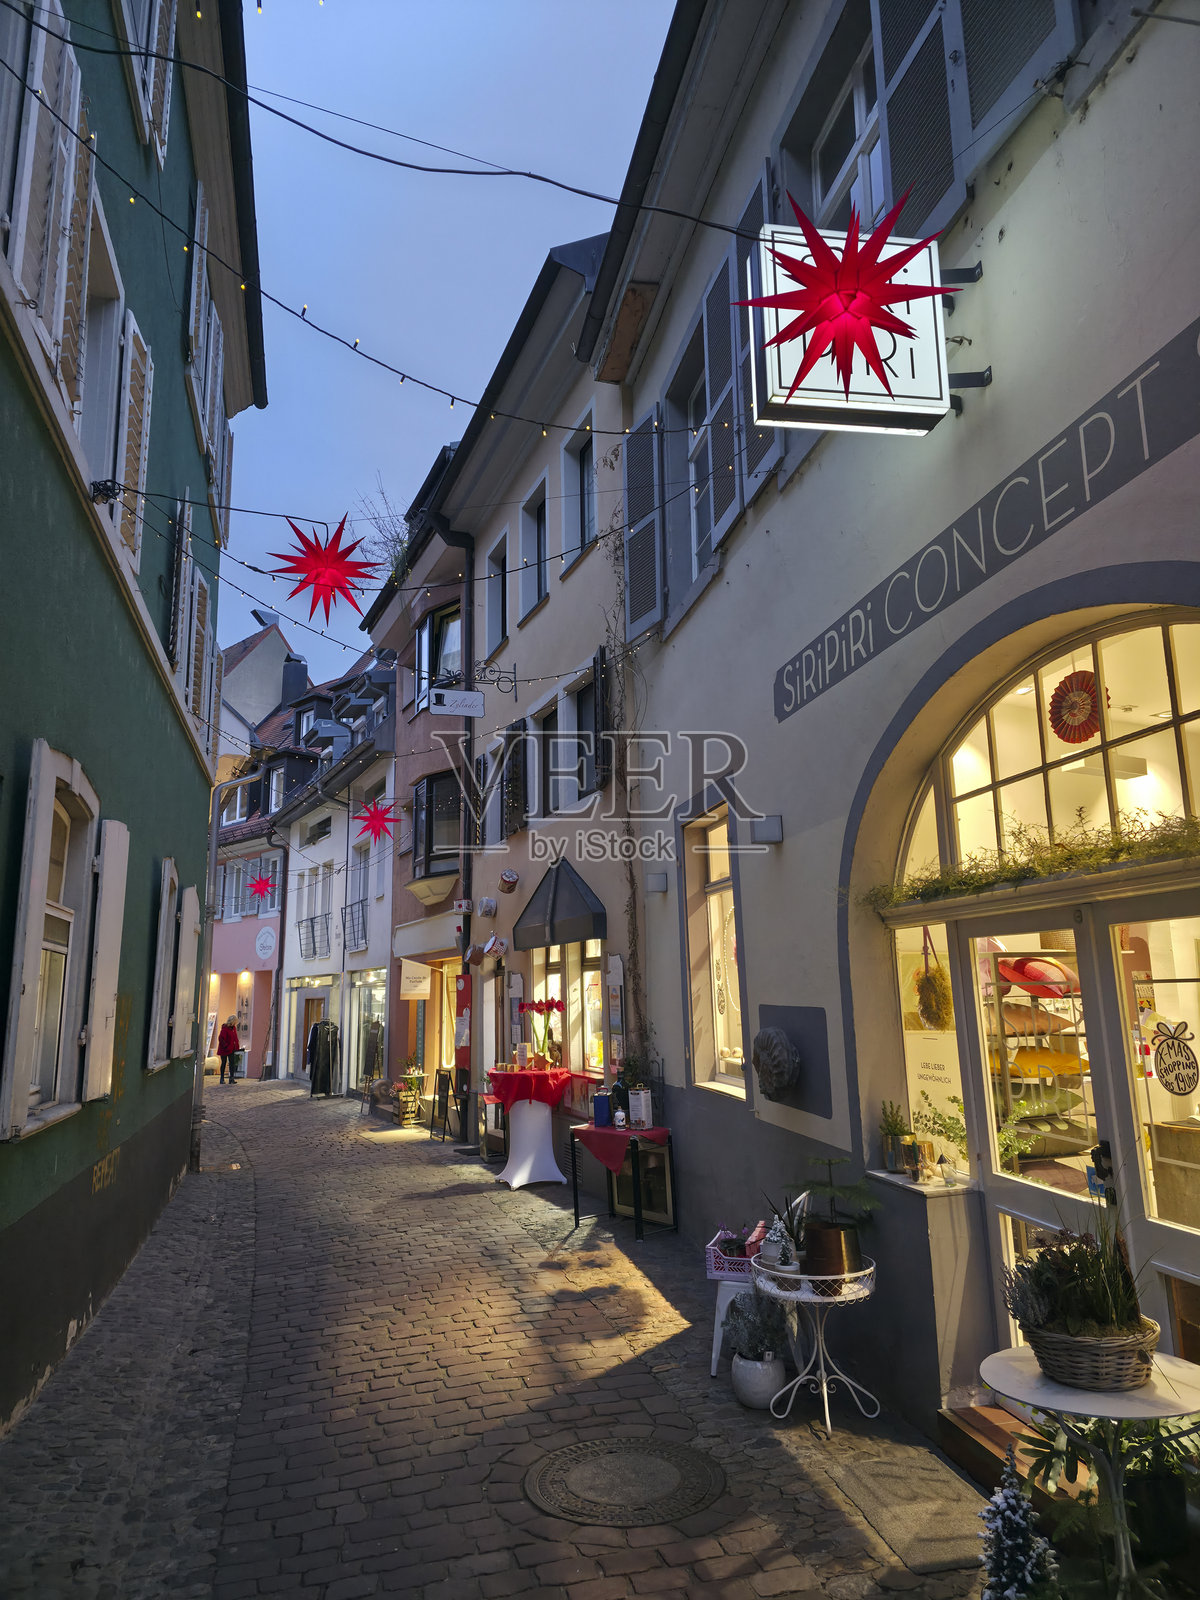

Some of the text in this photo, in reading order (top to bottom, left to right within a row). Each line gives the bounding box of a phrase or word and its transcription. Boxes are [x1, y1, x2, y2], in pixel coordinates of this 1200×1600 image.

[885, 361, 1160, 634] CONCEPT
[1158, 1041, 1191, 1067] X-MAS
[1160, 1060, 1196, 1079] SHOPPING
